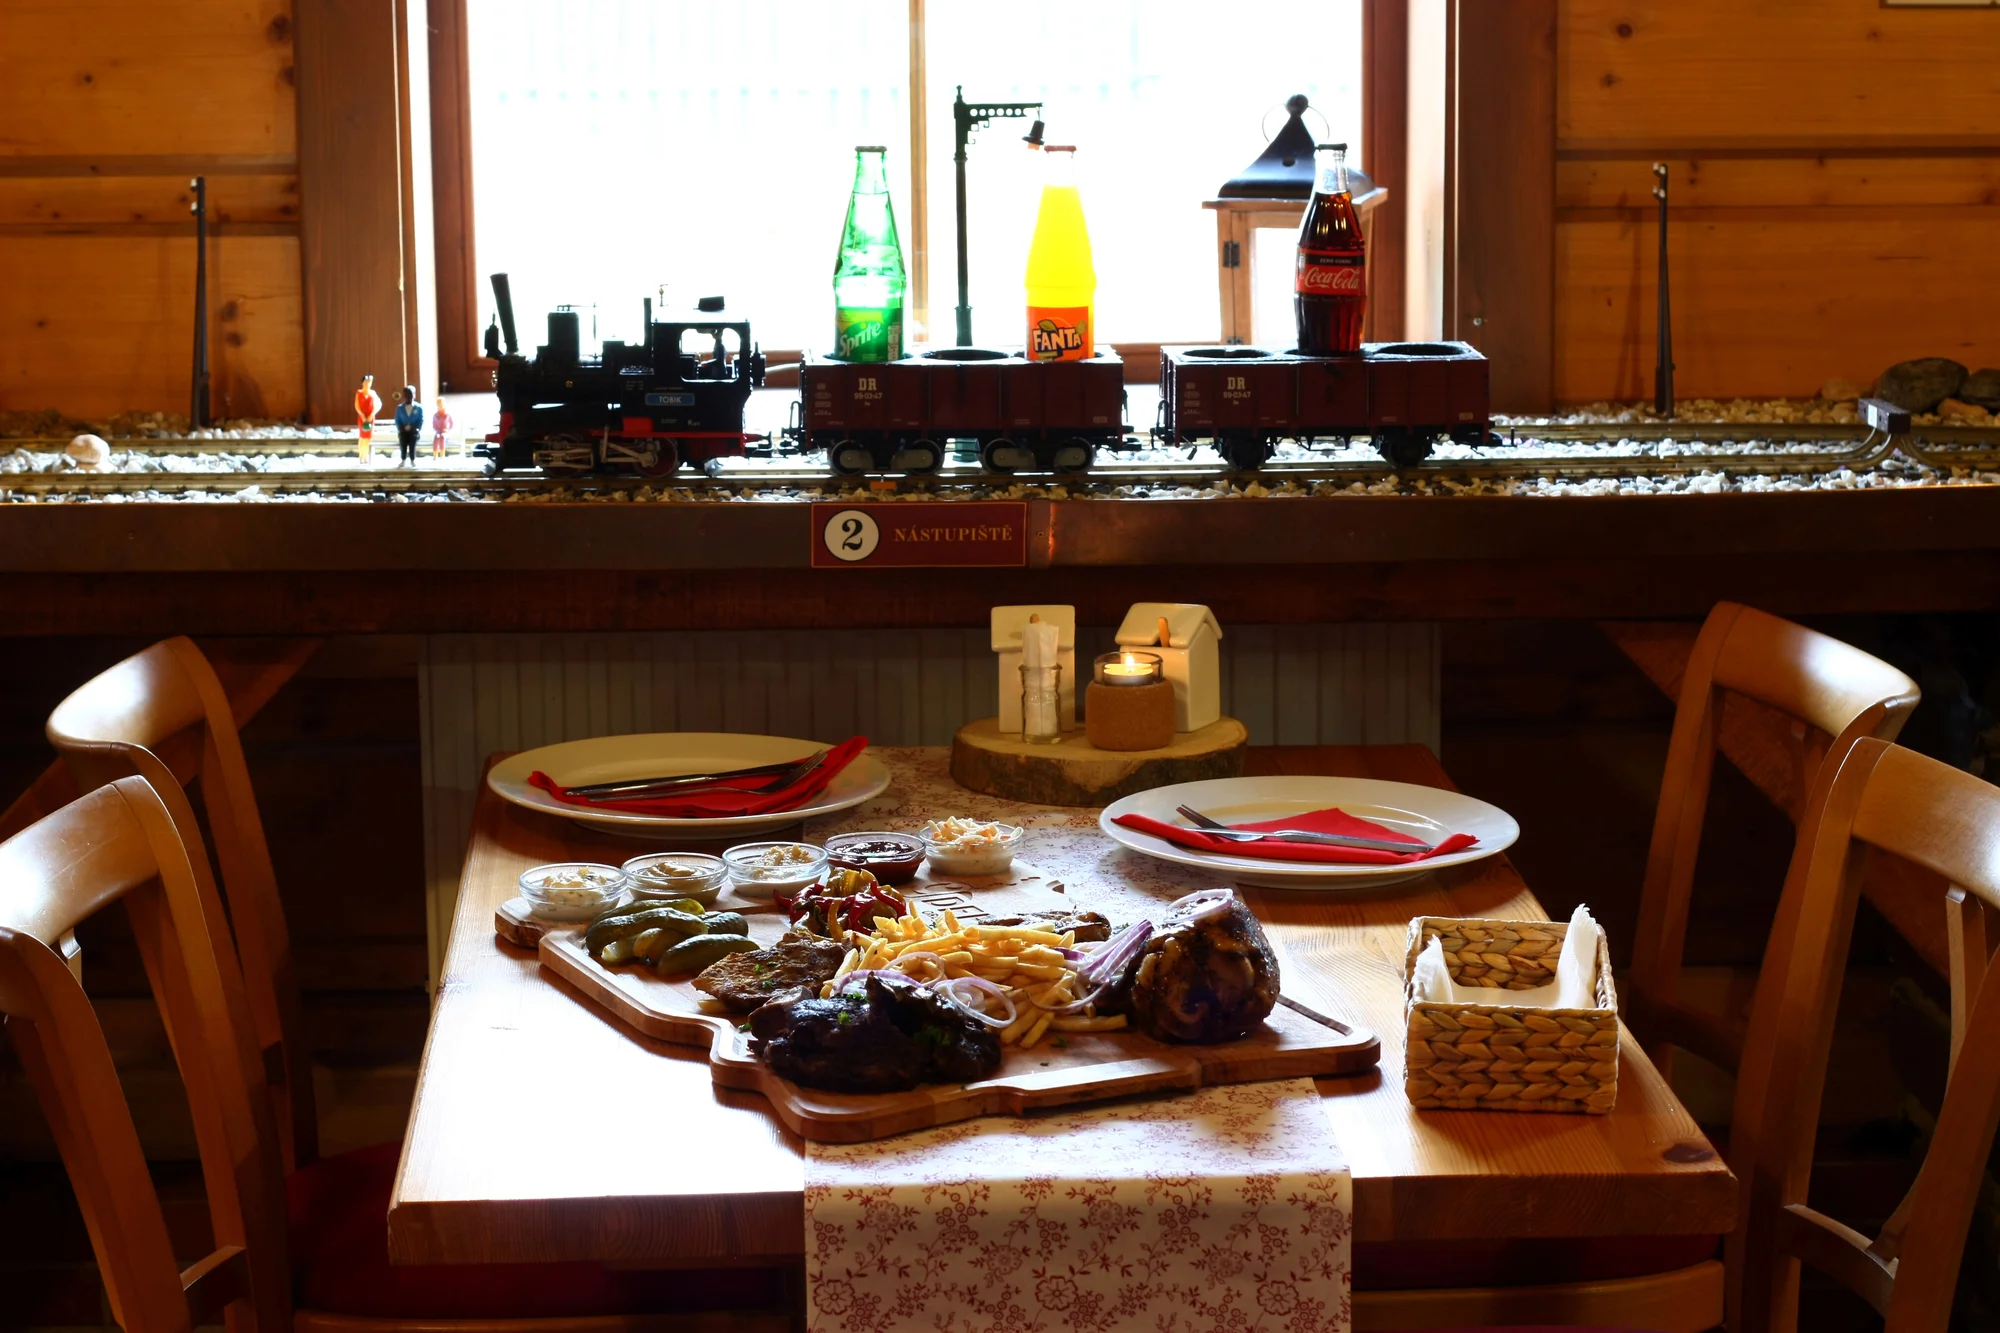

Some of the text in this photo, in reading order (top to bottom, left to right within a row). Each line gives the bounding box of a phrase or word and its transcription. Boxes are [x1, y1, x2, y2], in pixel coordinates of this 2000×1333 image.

[839, 322, 882, 357] Sprite
[1032, 326, 1082, 352] FANTA
[858, 377, 877, 391] DR
[1227, 376, 1246, 390] DR
[658, 395, 682, 404] TOBIK
[842, 519, 1013, 550] 2 NÁSTUPIŠTĚ
